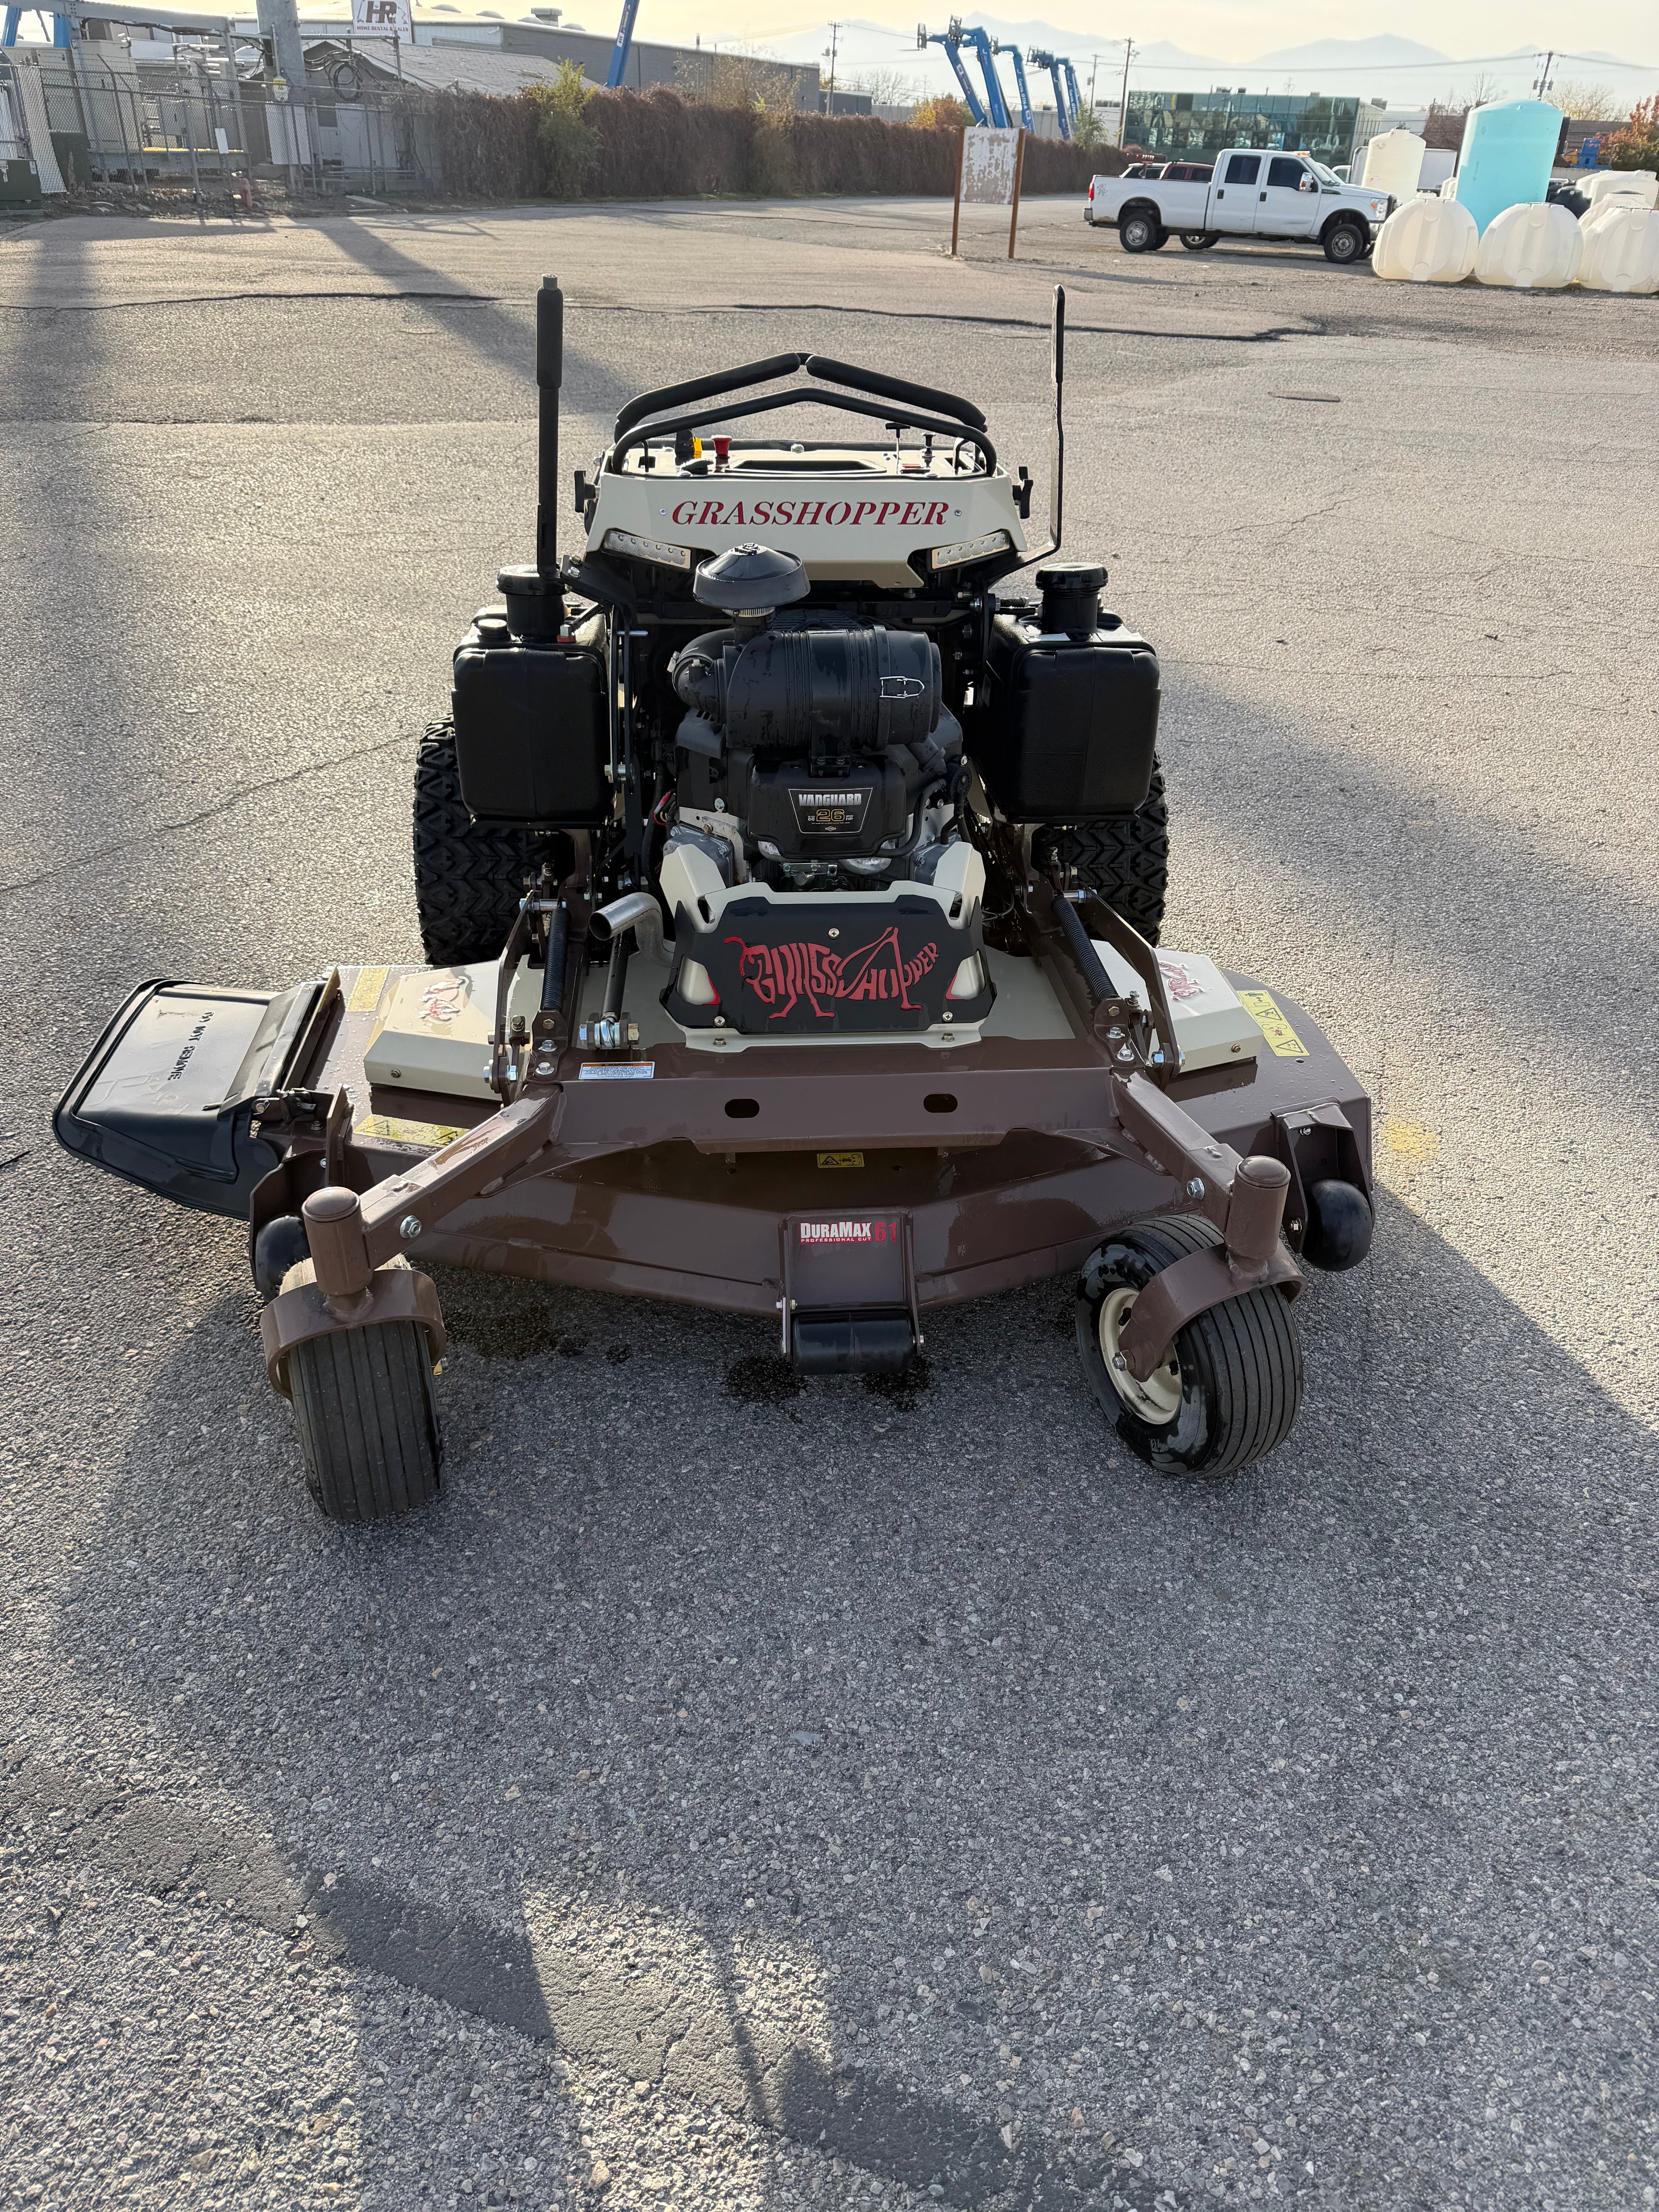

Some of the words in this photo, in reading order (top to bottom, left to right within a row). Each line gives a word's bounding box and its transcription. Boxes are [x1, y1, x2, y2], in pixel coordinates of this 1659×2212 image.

[366, 0, 397, 24] HR
[672, 501, 950, 525] GRASSHOPPER
[799, 793, 862, 806] VANGUARD
[816, 809, 845, 822] 26
[188, 1025, 207, 1041] NOT
[167, 1046, 196, 1081] REMOVE
[874, 1221, 897, 1242] 61
